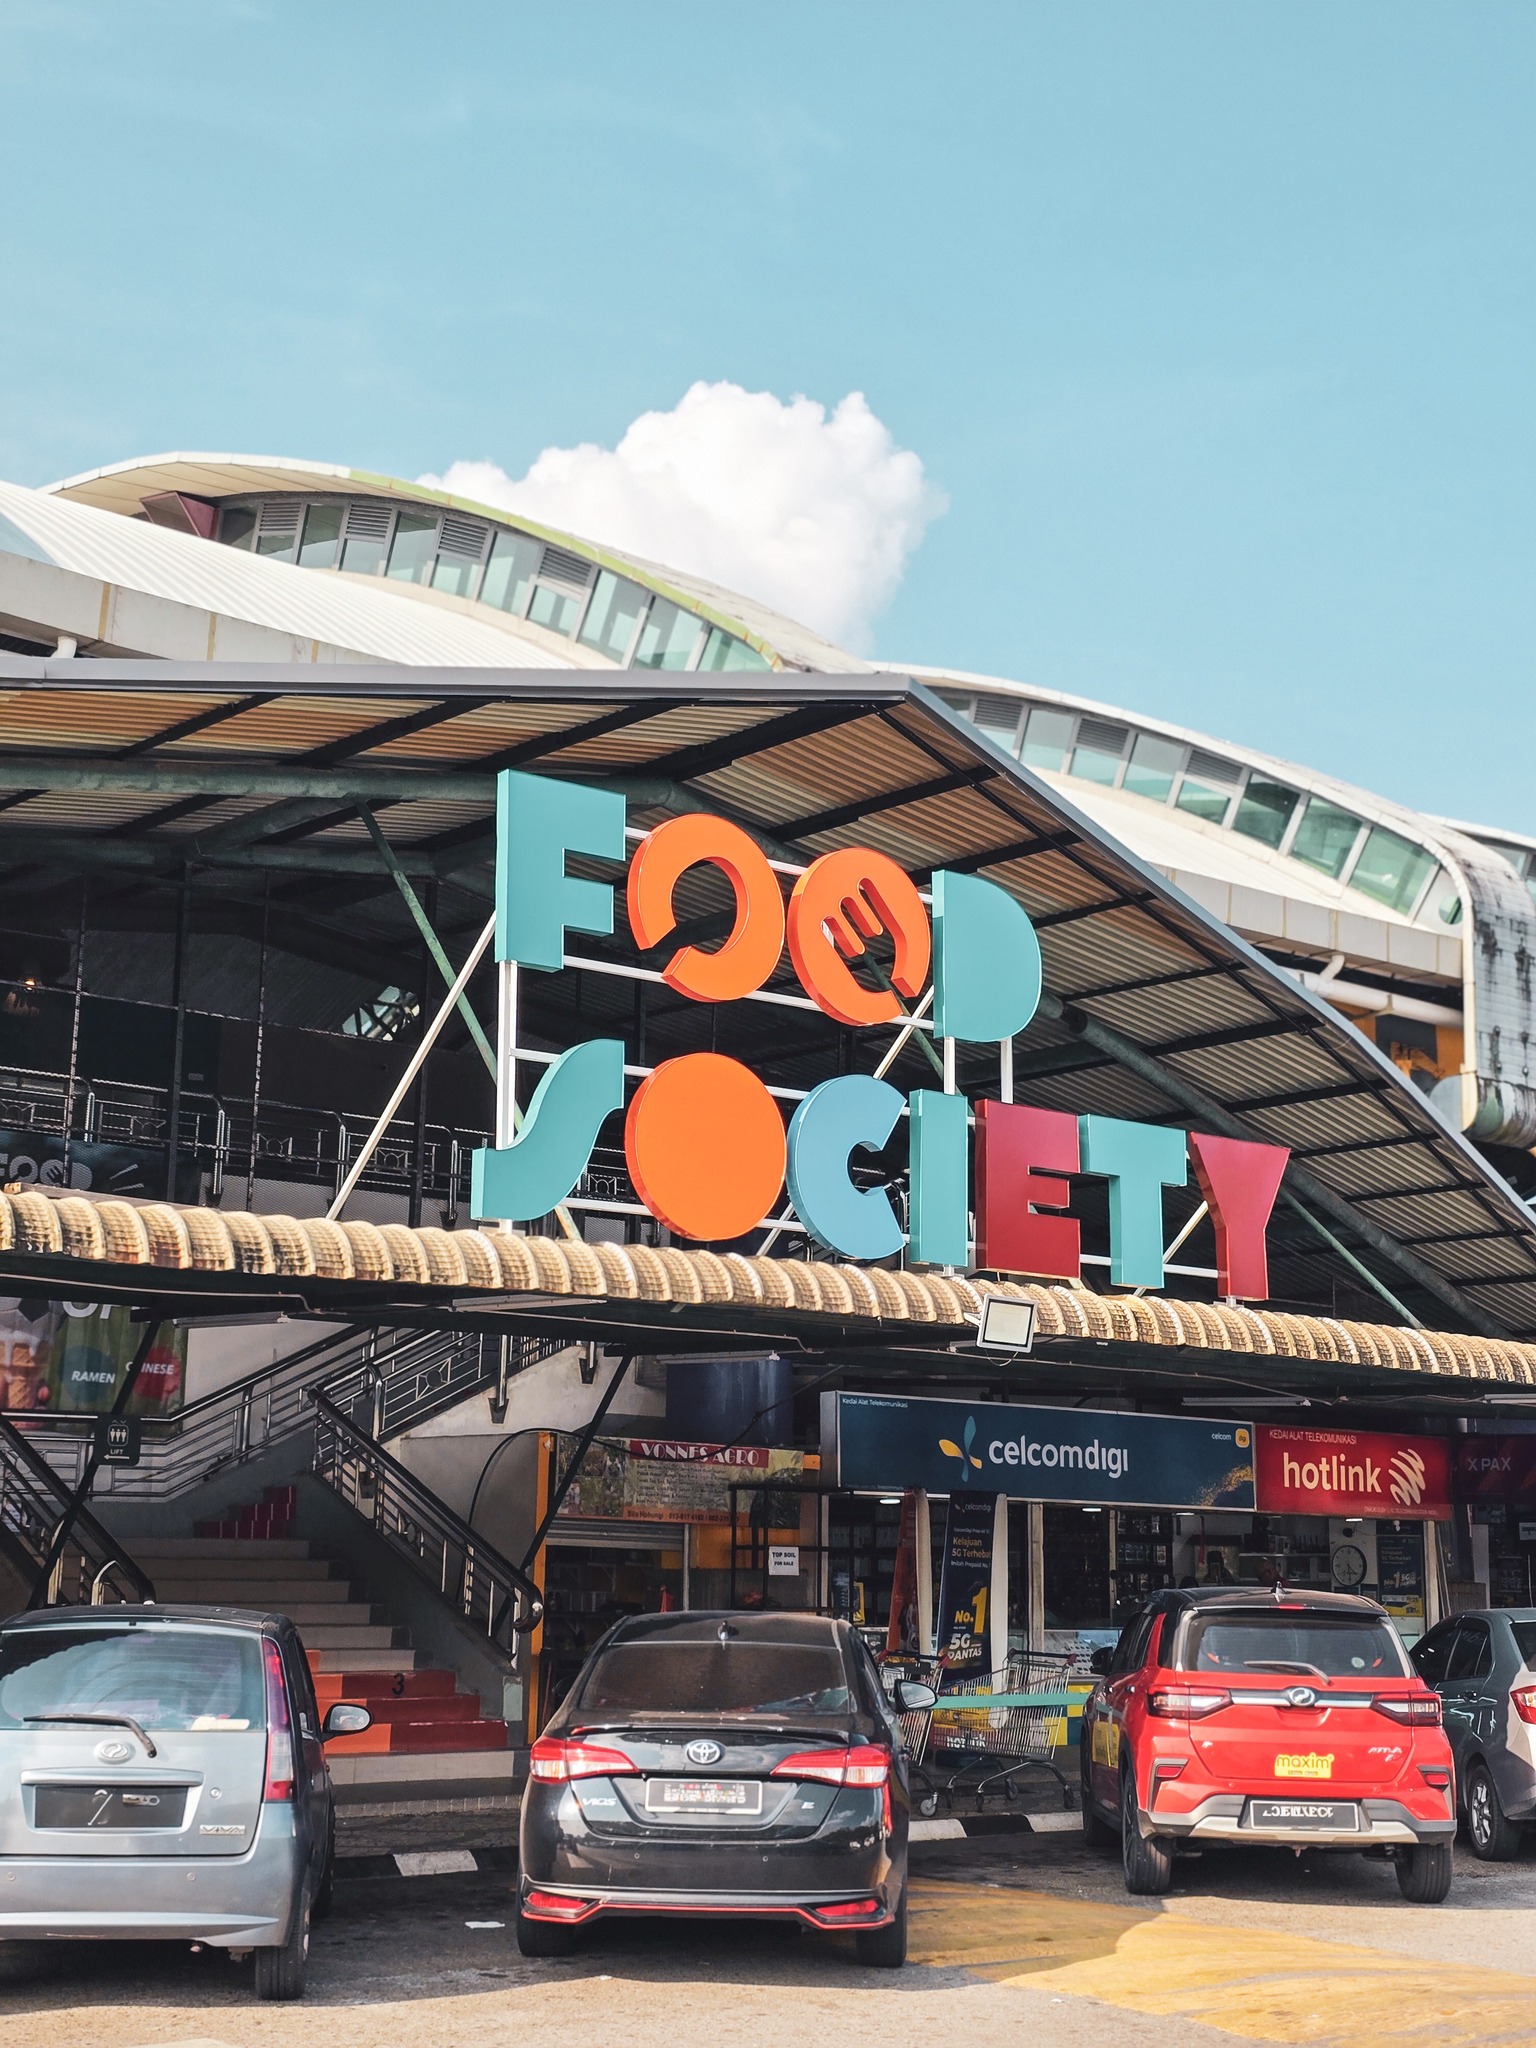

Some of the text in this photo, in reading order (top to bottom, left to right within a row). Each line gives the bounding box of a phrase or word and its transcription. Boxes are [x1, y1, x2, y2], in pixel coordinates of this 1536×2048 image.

[495, 769, 1042, 1042] FOOD
[471, 1038, 1292, 1301] SOCIETY
[125, 1361, 175, 1375] CINESE
[71, 1370, 116, 1384] RAMEN
[842, 1397, 858, 1405] Kedai
[869, 1399, 908, 1408] Telekomunikasi
[1211, 1433, 1232, 1441] celcom
[1269, 1429, 1357, 1445] KEDAI ALAT TELEKOMUNIKASI
[640, 1442, 760, 1466] VONNES AGRO
[1283, 1452, 1382, 1493] hotlink
[952, 1536, 983, 1548] Kelajuan
[951, 1548, 962, 1557] 5G
[954, 1586, 988, 1635] No. 1
[948, 1633, 971, 1650] 5G
[391, 1672, 405, 1696] 3
[1276, 1753, 1330, 1769] maxim
[582, 1797, 617, 1807] VIOS
[200, 1825, 246, 1835] VIVA
